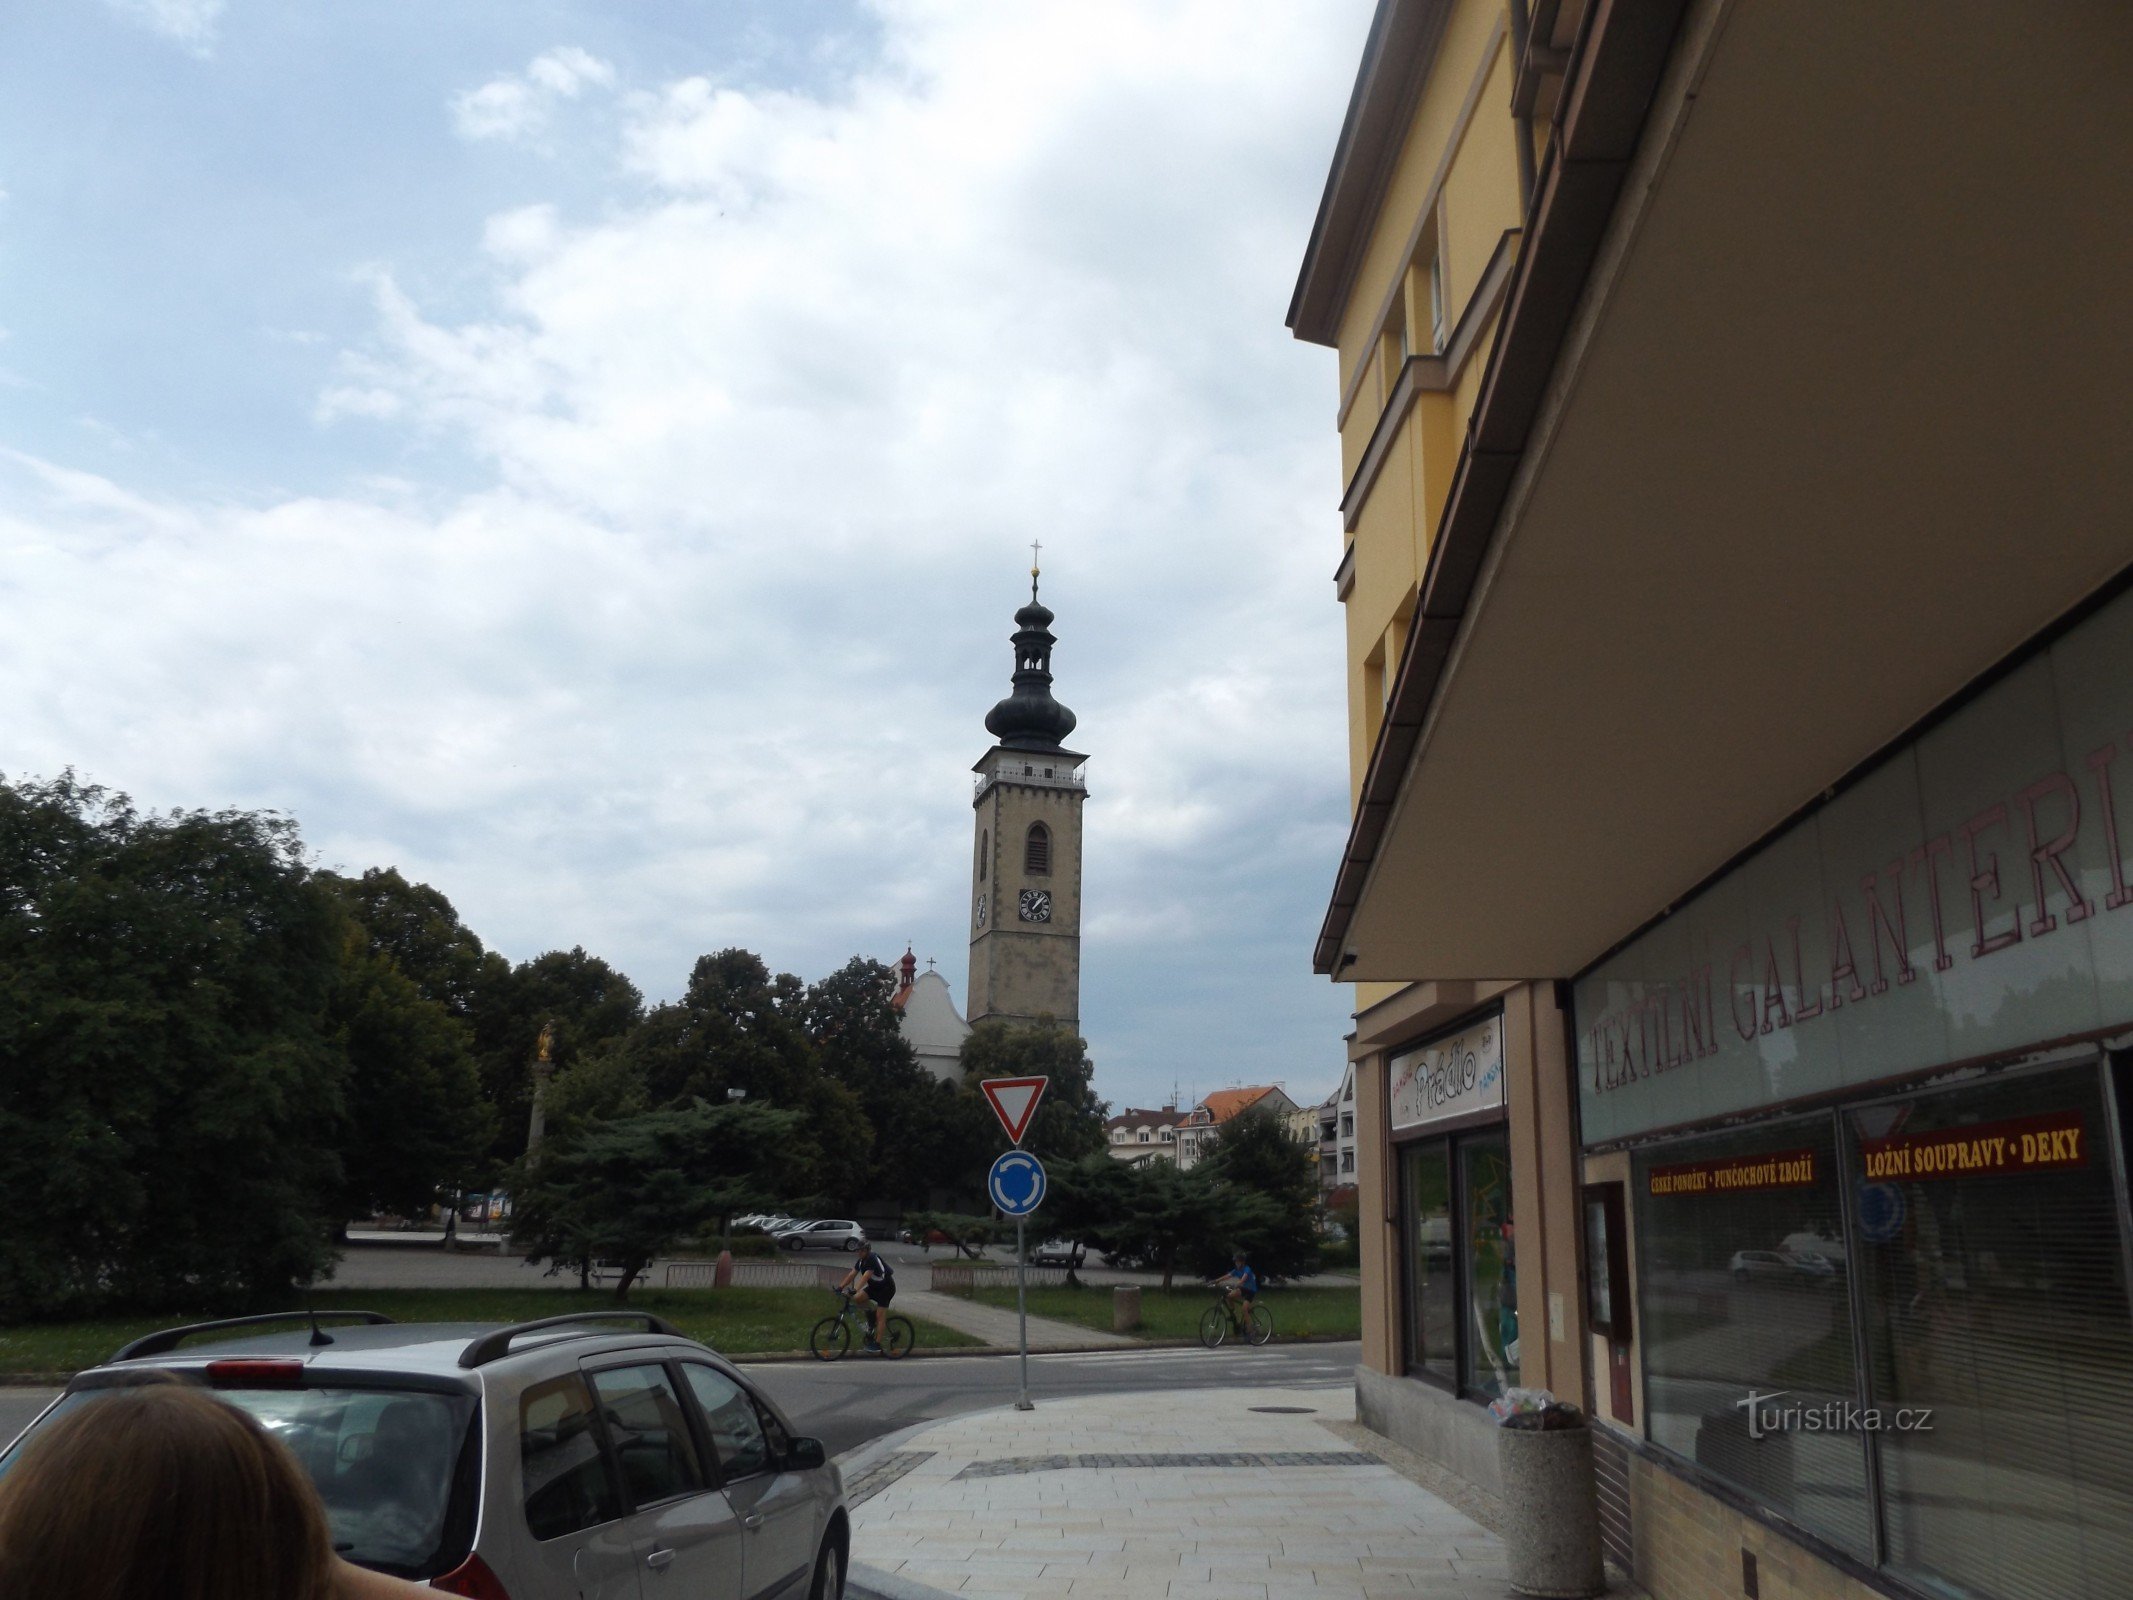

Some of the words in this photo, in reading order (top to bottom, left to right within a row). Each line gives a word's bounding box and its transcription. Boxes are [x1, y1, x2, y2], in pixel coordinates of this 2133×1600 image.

[1731, 730, 2133, 1041] GALANTERI
[1415, 1038, 1476, 1117] Prádlo
[1673, 1168, 1707, 1192] PONOŽKY
[1714, 1158, 1776, 1188] PUNČOCHOVÉ
[1779, 1154, 1813, 1182] ZBOŽÍ
[1866, 1143, 1911, 1177] LOŽNÍ
[1914, 1137, 2005, 1173] SOUPRAVY
[2021, 1128, 2080, 1163] DEKY
